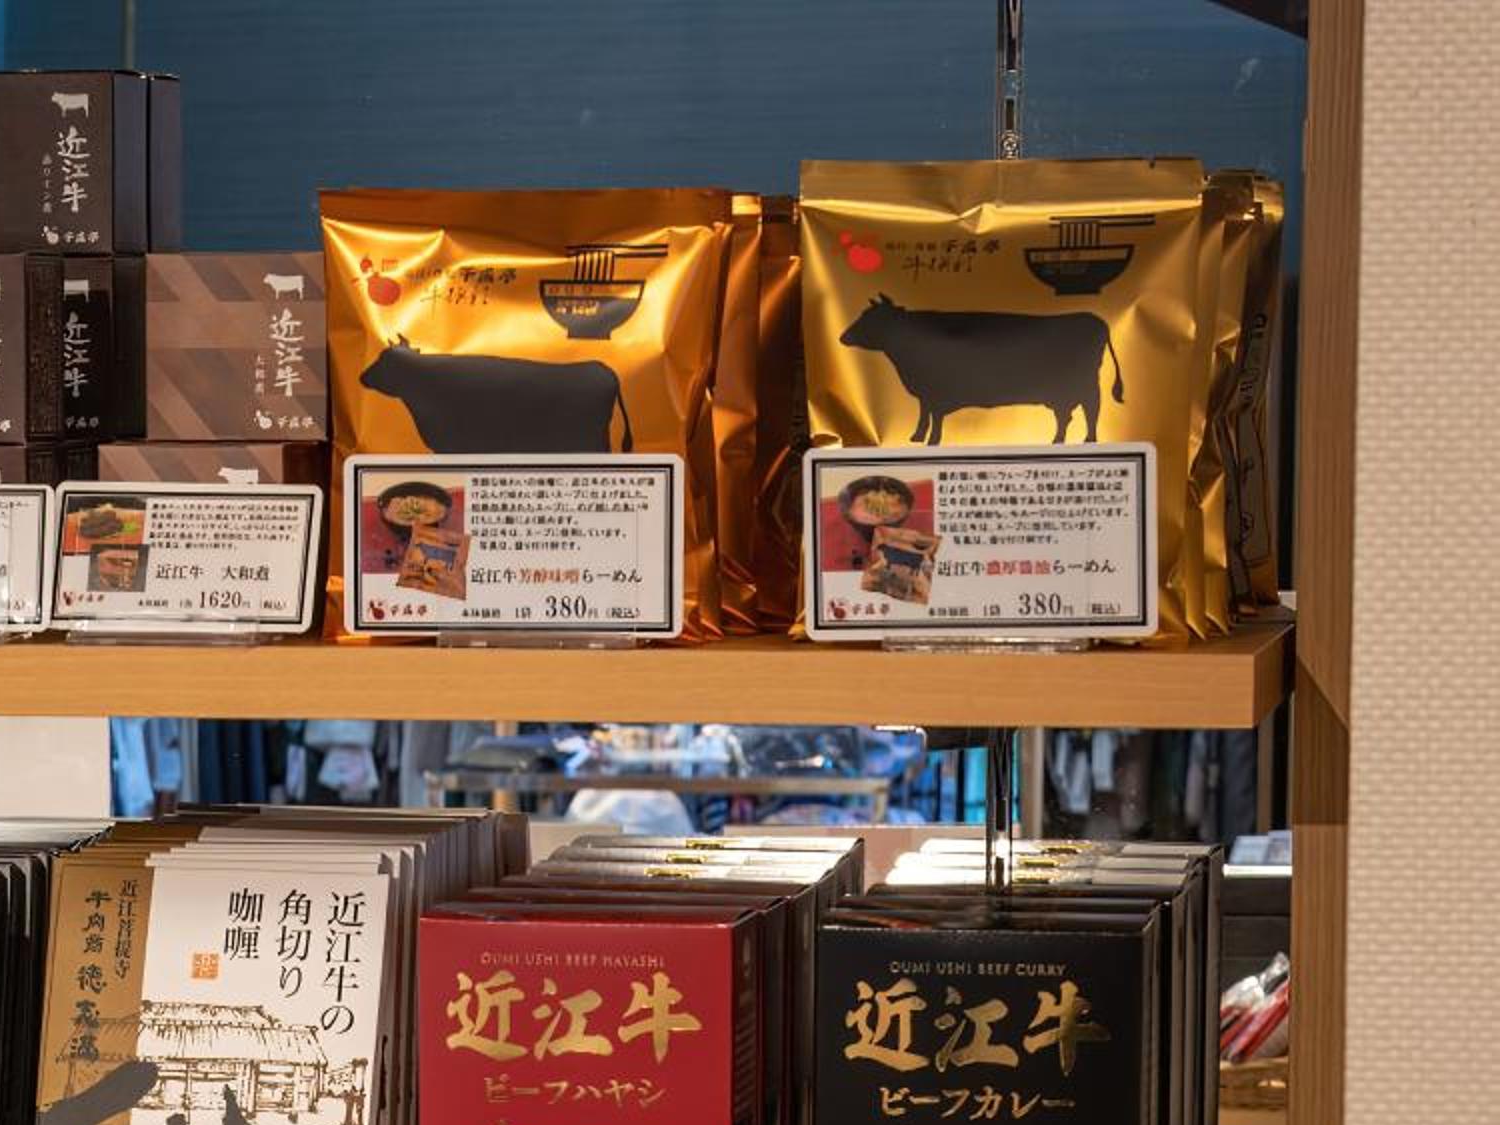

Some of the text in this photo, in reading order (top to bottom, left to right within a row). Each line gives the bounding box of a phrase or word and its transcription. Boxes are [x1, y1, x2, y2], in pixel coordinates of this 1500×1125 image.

[57, 126, 91, 213] 近江牛
[63, 311, 91, 399] 近江牛
[269, 308, 305, 398] 近江牛
[156, 565, 270, 581] 近江牛 大和煮
[276, 889, 311, 999] 角切り
[321, 891, 366, 1035] 近江牛の
[480, 952, 664, 968] OUMI USHI BEEF HAYASHI
[890, 961, 1066, 976] OUMI USHI BEEF CURRY
[446, 970, 702, 1064] 近江牛
[844, 978, 1111, 1076] 近江牛
[484, 1073, 666, 1109] ビーフハヤシ
[879, 1087, 1075, 1120] ビーフカレー
